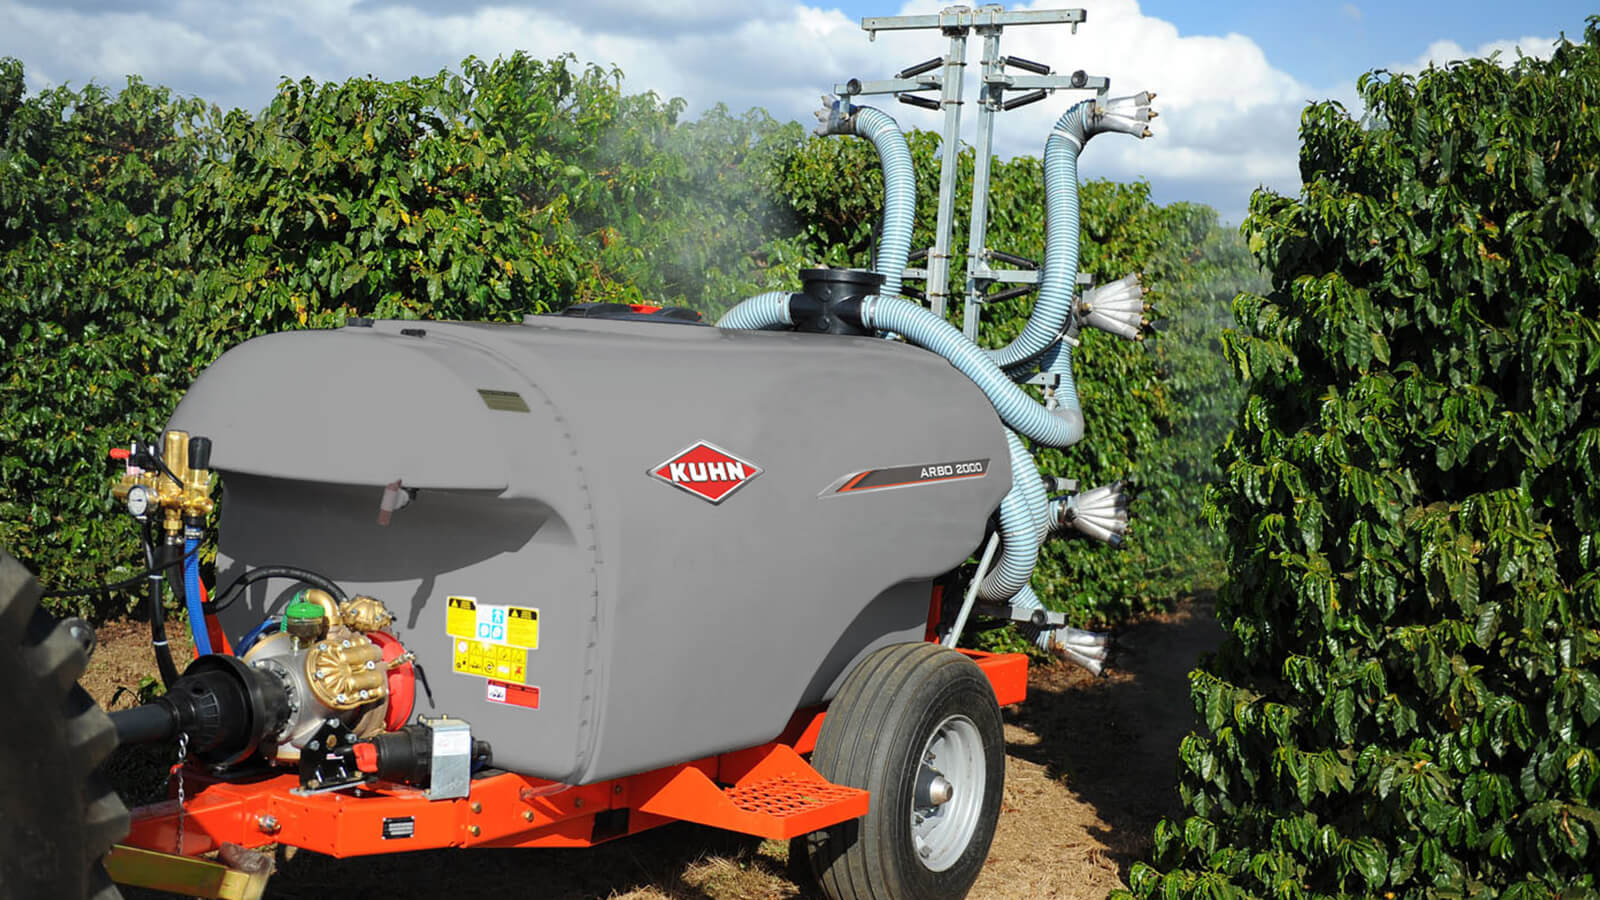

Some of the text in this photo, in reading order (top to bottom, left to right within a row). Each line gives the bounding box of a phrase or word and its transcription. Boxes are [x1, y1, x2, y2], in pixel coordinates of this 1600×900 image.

[669, 461, 746, 482] KUHN
[920, 462, 983, 478] ARBO 2000
